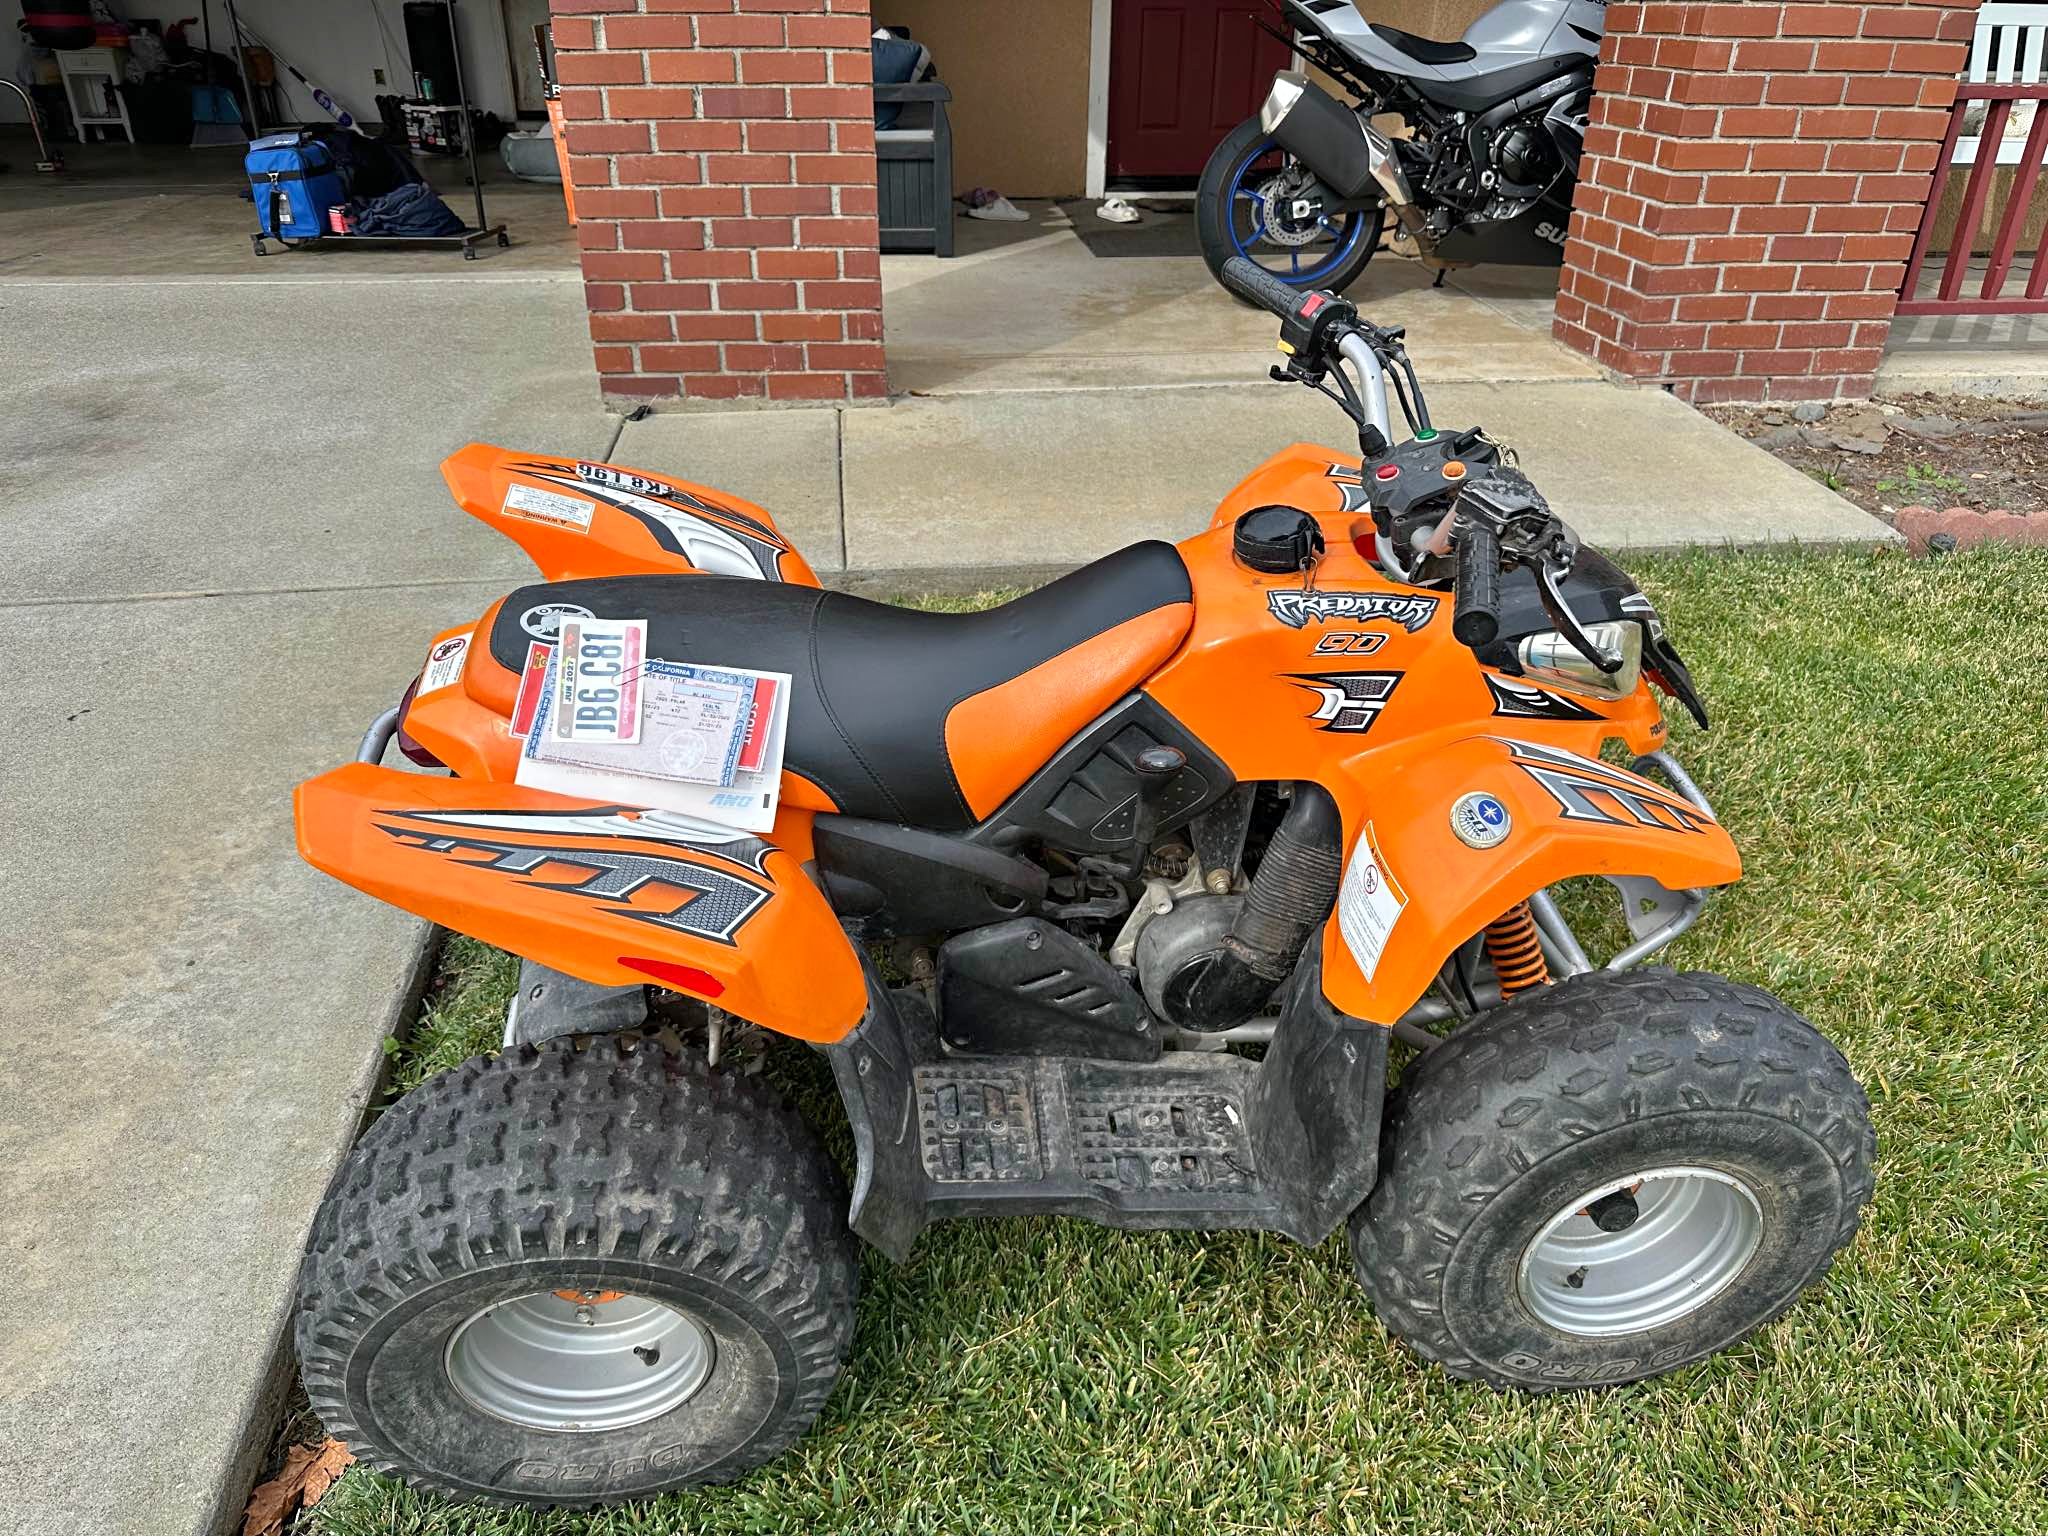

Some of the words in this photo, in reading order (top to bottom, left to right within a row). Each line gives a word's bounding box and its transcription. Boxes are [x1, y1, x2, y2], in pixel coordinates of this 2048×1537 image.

[1534, 222, 1567, 247] SU
[577, 464, 621, 484] L96
[523, 511, 558, 524] WARNING
[1267, 590, 1440, 633] PREDATOR
[579, 633, 624, 677] C81
[1312, 631, 1390, 656] 90
[566, 660, 575, 682] 2027
[564, 685, 573, 702] JUN
[575, 688, 620, 733] JB6
[1499, 1340, 1692, 1381] DURO
[515, 1441, 684, 1482] DURO
